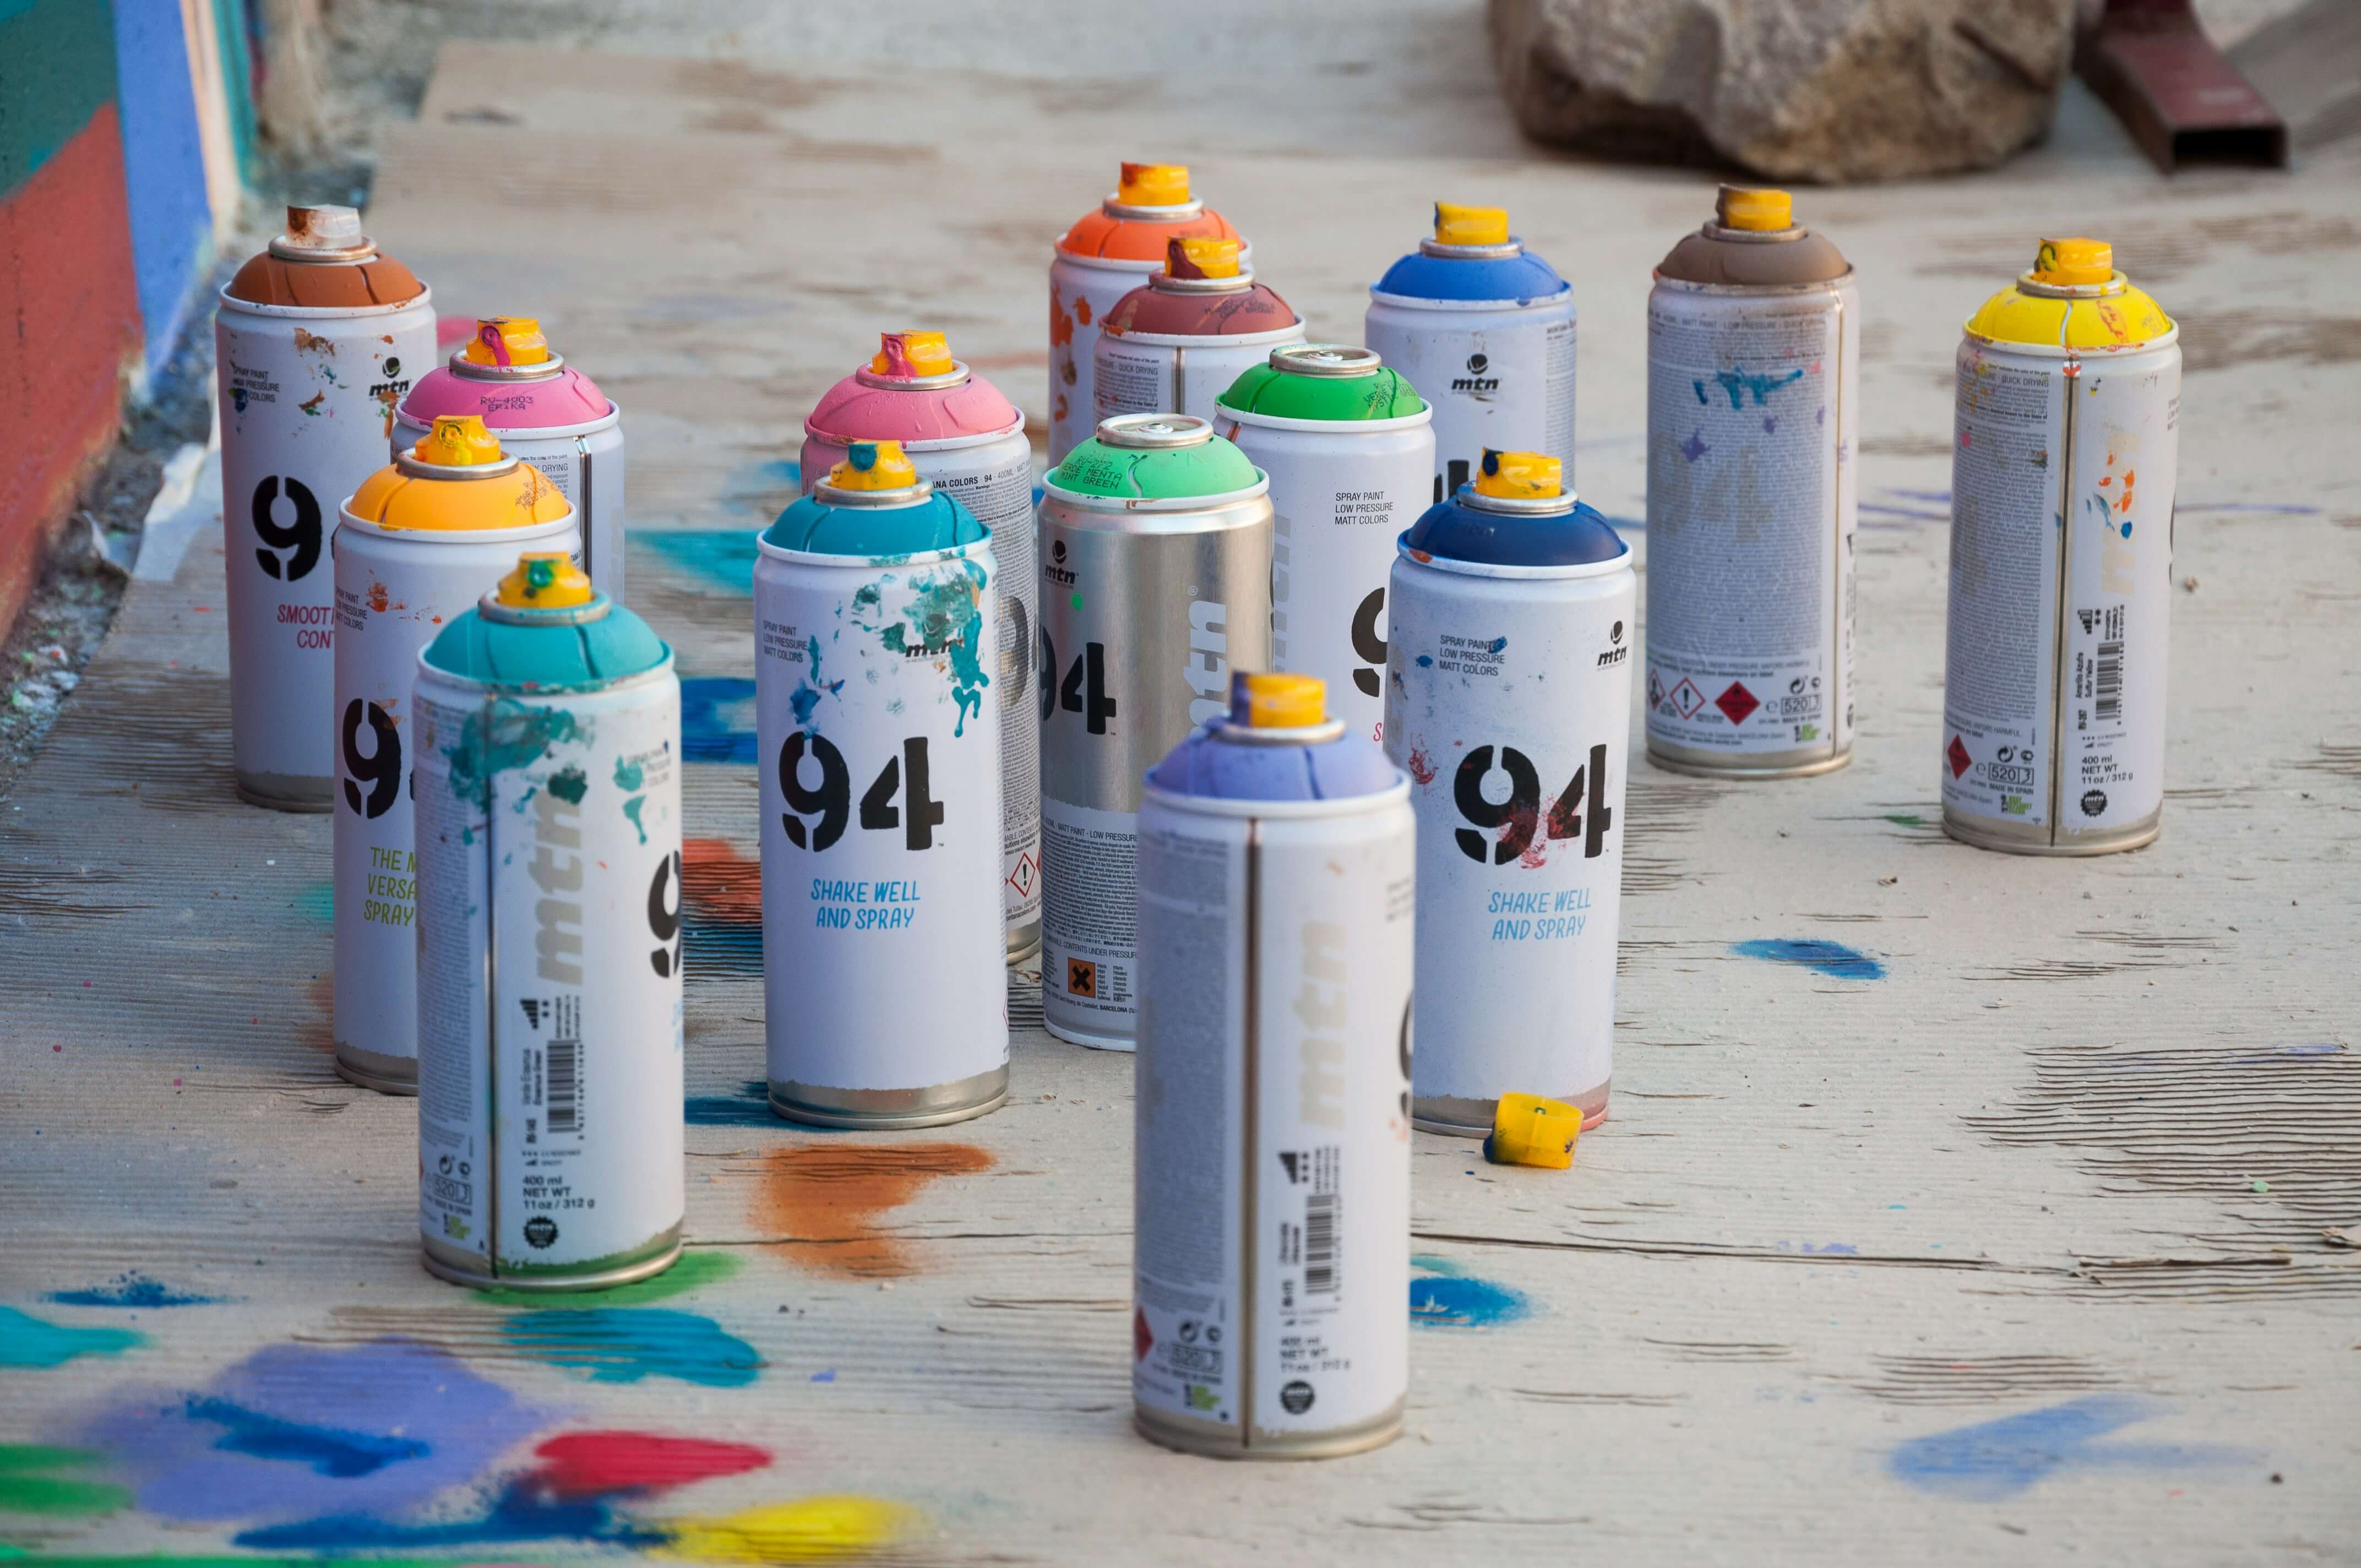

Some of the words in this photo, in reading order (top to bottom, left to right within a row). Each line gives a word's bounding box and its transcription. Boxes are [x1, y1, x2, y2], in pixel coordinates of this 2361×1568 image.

[250, 370, 269, 380] PAINT
[1135, 365, 1158, 375] DRYING
[246, 380, 280, 392] PRESSURE
[1451, 377, 1499, 391] mtn
[2002, 374, 2022, 385] QUICK
[2022, 378, 2049, 388] DRYING
[249, 391, 275, 402] COLORS
[542, 463, 568, 472] DRYING
[1086, 468, 1123, 481] MENTA
[949, 476, 978, 487] COLORS
[984, 474, 992, 482] 94
[998, 469, 1013, 478] 400ML
[1083, 476, 1119, 489] GREEN
[1335, 492, 1361, 502] SPRAY
[1363, 491, 1385, 501] PAINT
[1335, 504, 1354, 513] LOW
[1356, 502, 1394, 513] PRESSURE
[1335, 515, 1356, 525] MATT
[1359, 514, 1389, 525] COLORS
[1045, 564, 1076, 584] mtn
[345, 591, 359, 604] PAINT
[342, 602, 368, 620] PRESSURE
[344, 614, 363, 631] COLORS
[763, 620, 777, 634] SPRAY
[779, 625, 797, 636] PAINT
[763, 634, 774, 644] LOW
[775, 636, 807, 650] PRESSURE
[1440, 634, 1466, 646] SPRAY
[764, 646, 775, 657] MATT
[777, 649, 803, 662] COLORS
[905, 639, 958, 657] mn
[1440, 649, 1457, 659] LOW
[1460, 650, 1505, 664] PRESSURE
[1598, 648, 1626, 666] mtn
[1439, 660, 1460, 672] MATT
[1463, 663, 1498, 677] COLORS
[1785, 699, 1808, 713] 520
[2082, 755, 2099, 765] 400
[2102, 754, 2113, 763] ml
[1992, 765, 2016, 781] 520
[2082, 766, 2101, 774] NET
[2104, 764, 2118, 772] WT
[2112, 772, 2127, 782] 312
[778, 731, 945, 853] 94
[1989, 783, 2006, 793] MADE
[2008, 785, 2014, 793] IN
[2015, 786, 2034, 796] SPAIN
[1454, 744, 1612, 865] 94
[1070, 826, 1085, 836] PAINT
[1090, 830, 1105, 839] LOW
[371, 846, 401, 870] THE
[810, 879, 868, 903] SHAKE
[874, 880, 921, 903] WELL
[1488, 891, 1551, 914] SHAKE
[1554, 888, 1591, 912] WELL
[363, 900, 416, 927] SPRAY
[816, 906, 851, 929] AND
[855, 907, 915, 930] SPRAY
[1492, 919, 1531, 941] AND
[1535, 914, 1586, 940] SPRAY
[1063, 940, 1088, 953] CONTENTS
[1089, 947, 1108, 956] UNDER
[1100, 1004, 1128, 1013] BARCELONA
[523, 1175, 544, 1186] 400
[547, 1174, 563, 1185] ml
[523, 1187, 548, 1198] NET
[551, 1186, 572, 1197] WT
[563, 1199, 585, 1209] 312
[587, 1200, 595, 1210] g
